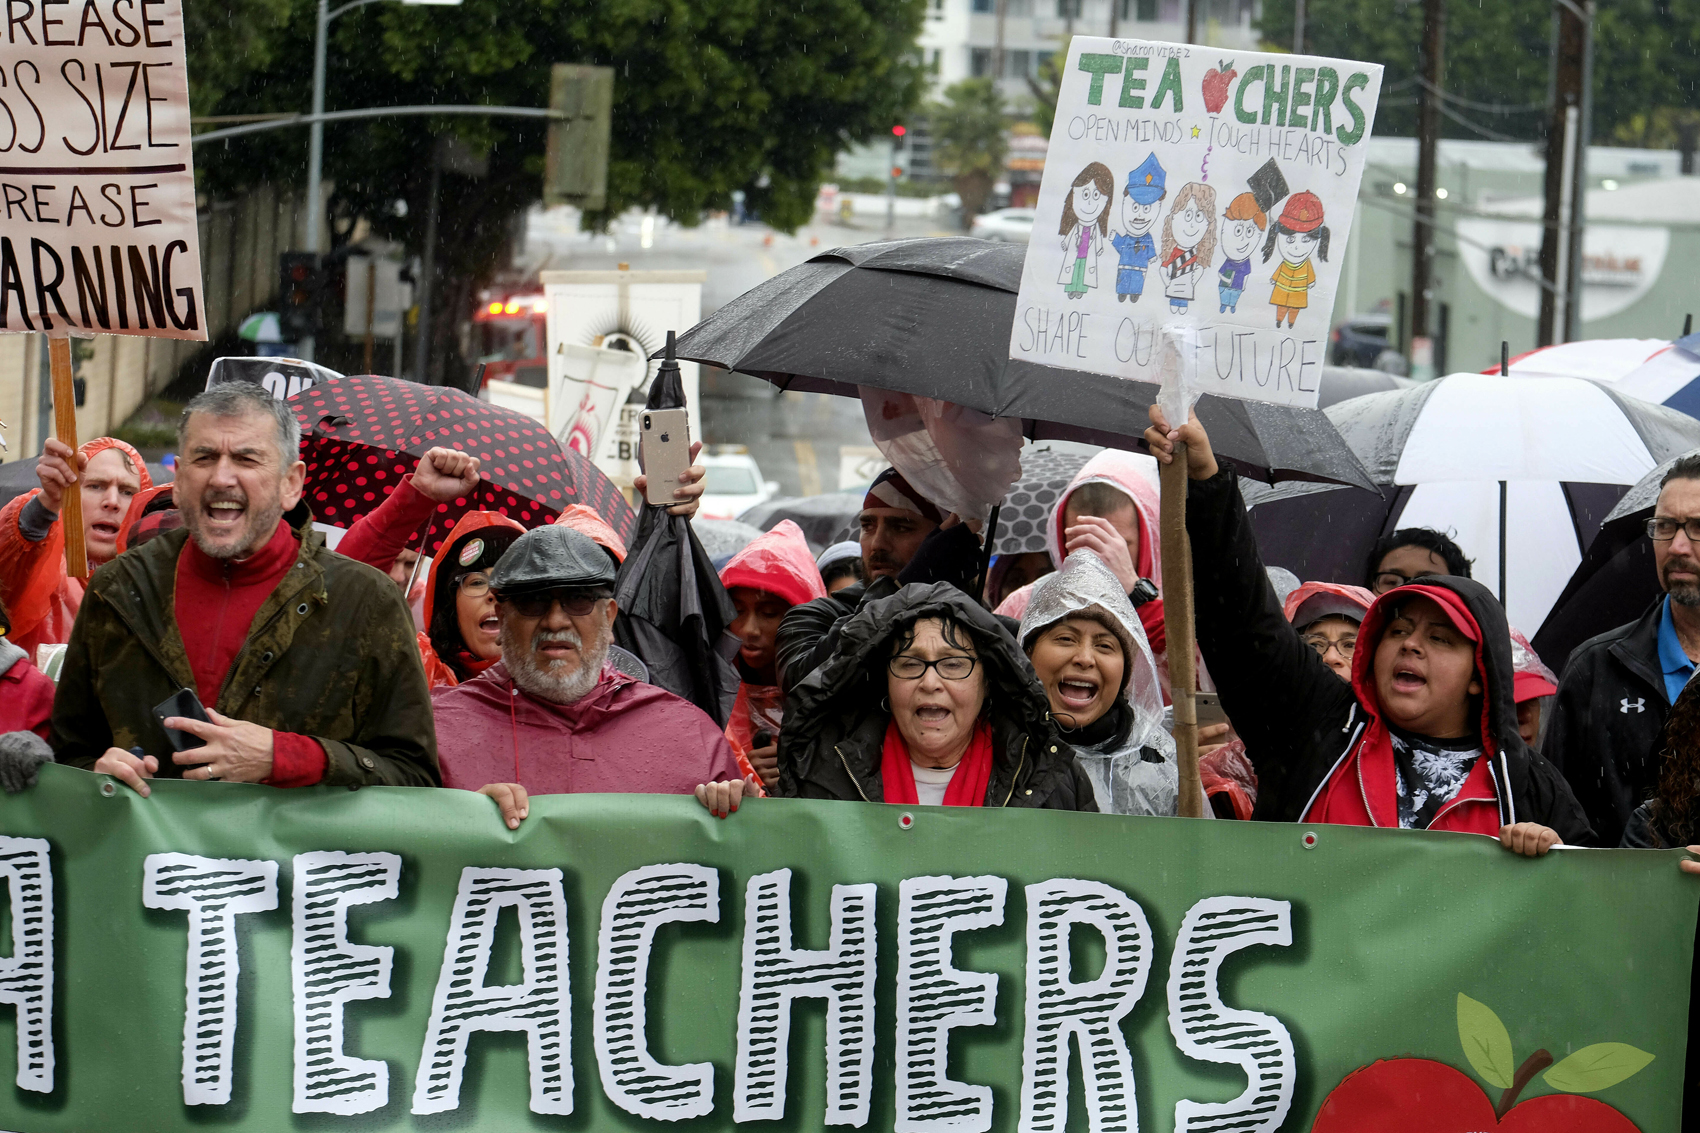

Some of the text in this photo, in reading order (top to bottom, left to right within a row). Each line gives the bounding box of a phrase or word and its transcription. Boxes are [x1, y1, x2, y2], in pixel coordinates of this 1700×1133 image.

[0, 0, 172, 47] REASE
[61, 59, 179, 156] SIZE
[1068, 114, 1346, 176] OPEN MINDS TOUCH HEARTS
[0, 183, 162, 228] REASE
[0, 236, 198, 330] ARNING
[1019, 307, 1316, 392] SHAPE OU FUTURE
[143, 849, 1296, 1133] TEACHERS
